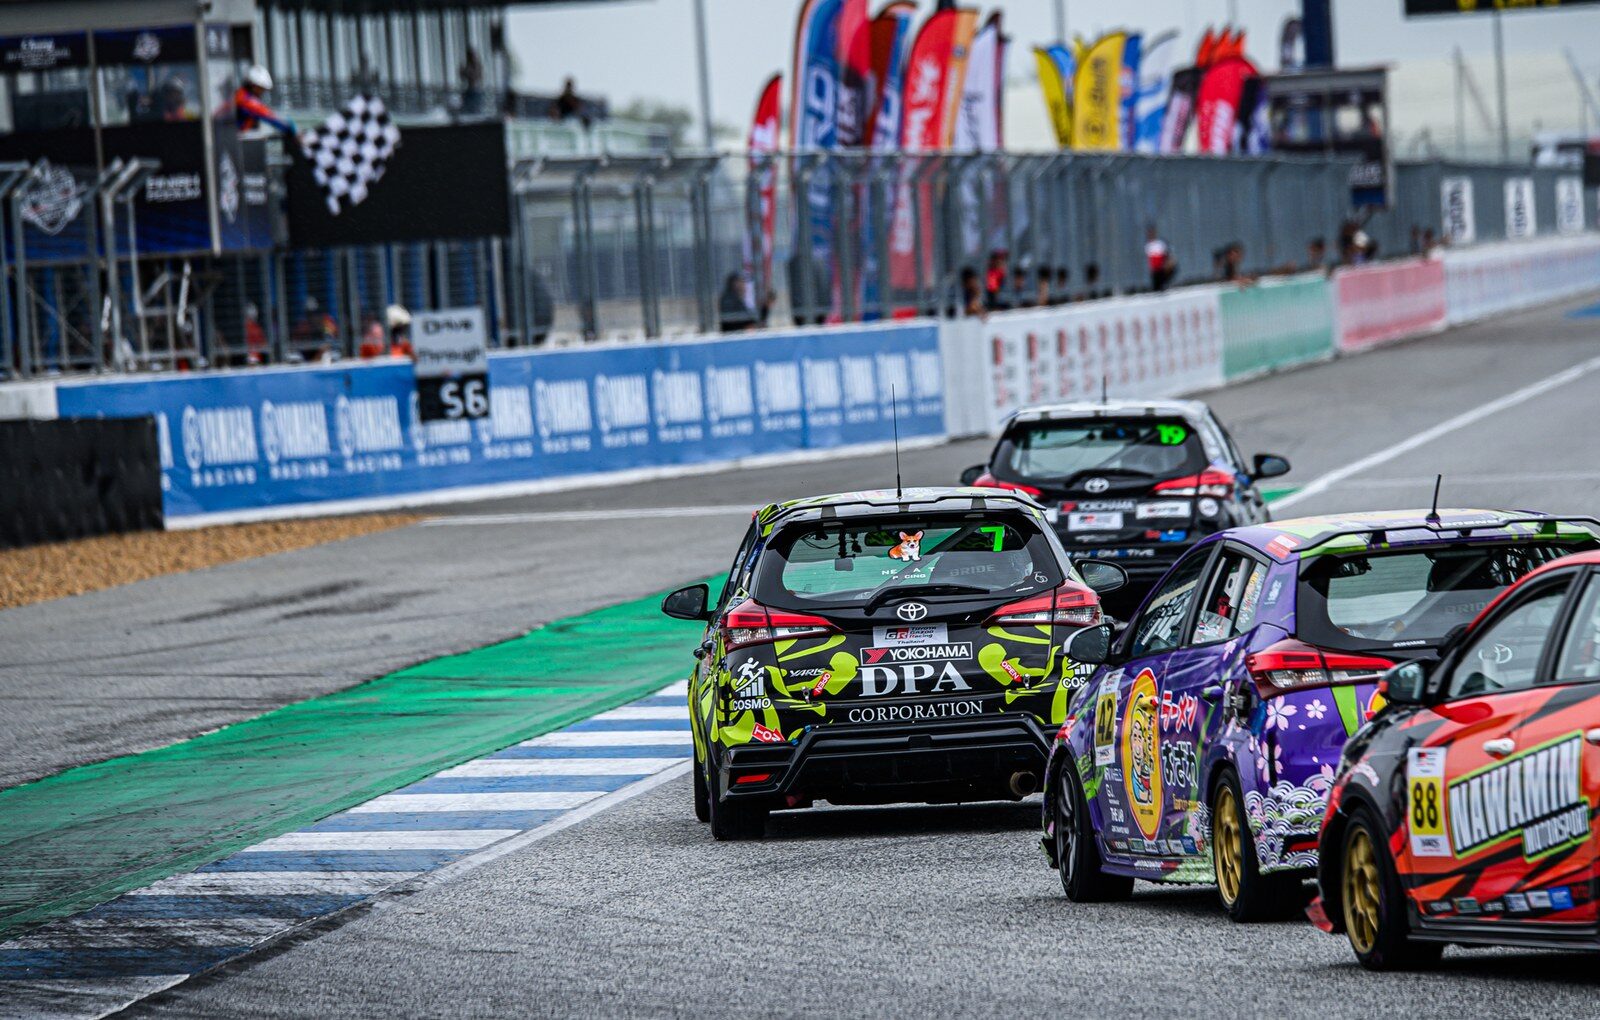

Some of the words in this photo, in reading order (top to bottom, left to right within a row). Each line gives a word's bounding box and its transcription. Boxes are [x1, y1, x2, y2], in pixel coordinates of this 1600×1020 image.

[439, 380, 487, 418] S6
[1156, 424, 1185, 444] 19
[980, 526, 1004, 552] 7
[950, 564, 996, 577] BRIDE
[889, 645, 970, 661] YOKOHAMA
[857, 661, 973, 697] DPA
[1001, 661, 1020, 680] OPEN
[815, 673, 831, 693] OPEN
[733, 698, 771, 711] COSMO
[848, 701, 984, 723] CORPORATION
[1160, 690, 1199, 735] ラーメン
[1097, 698, 1114, 742] 42
[1412, 782, 1439, 830] 88
[1450, 737, 1581, 852] NAWAMIN
